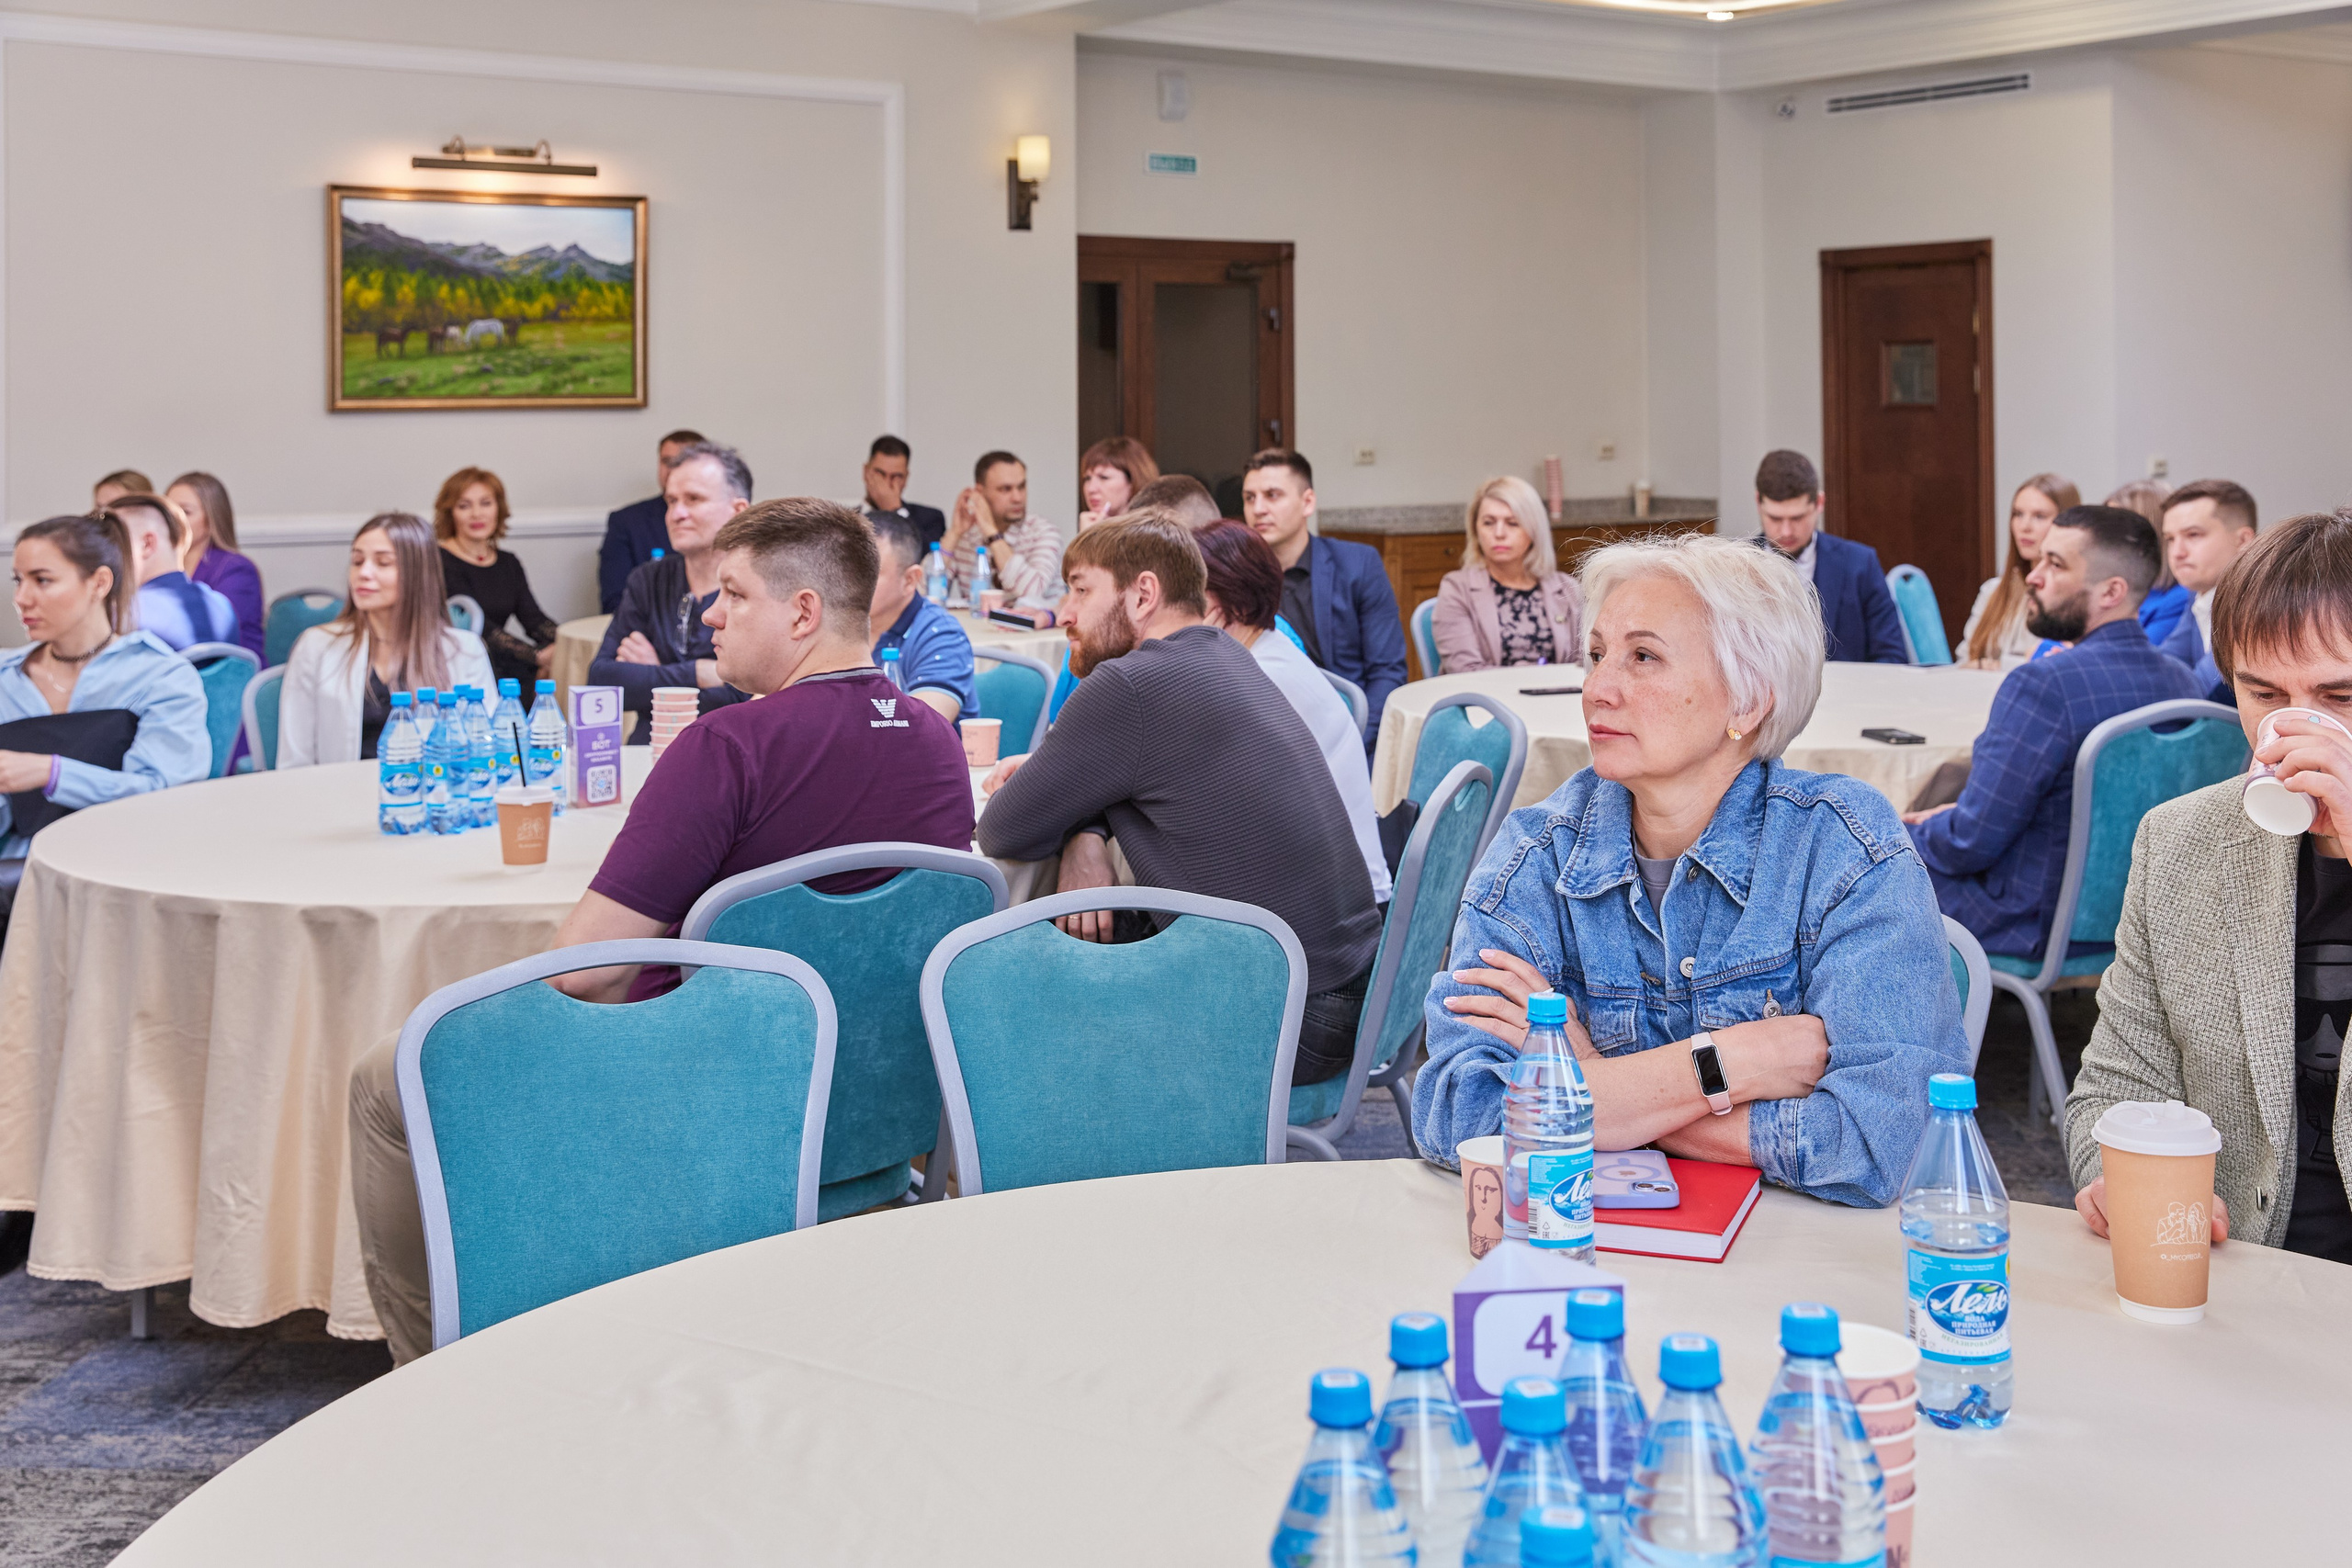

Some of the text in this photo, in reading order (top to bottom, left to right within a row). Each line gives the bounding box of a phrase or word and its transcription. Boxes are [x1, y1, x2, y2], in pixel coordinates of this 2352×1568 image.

[594, 698, 603, 713] 5
[1929, 1283, 2007, 1314] Лель
[1525, 1314, 1558, 1359] 4
